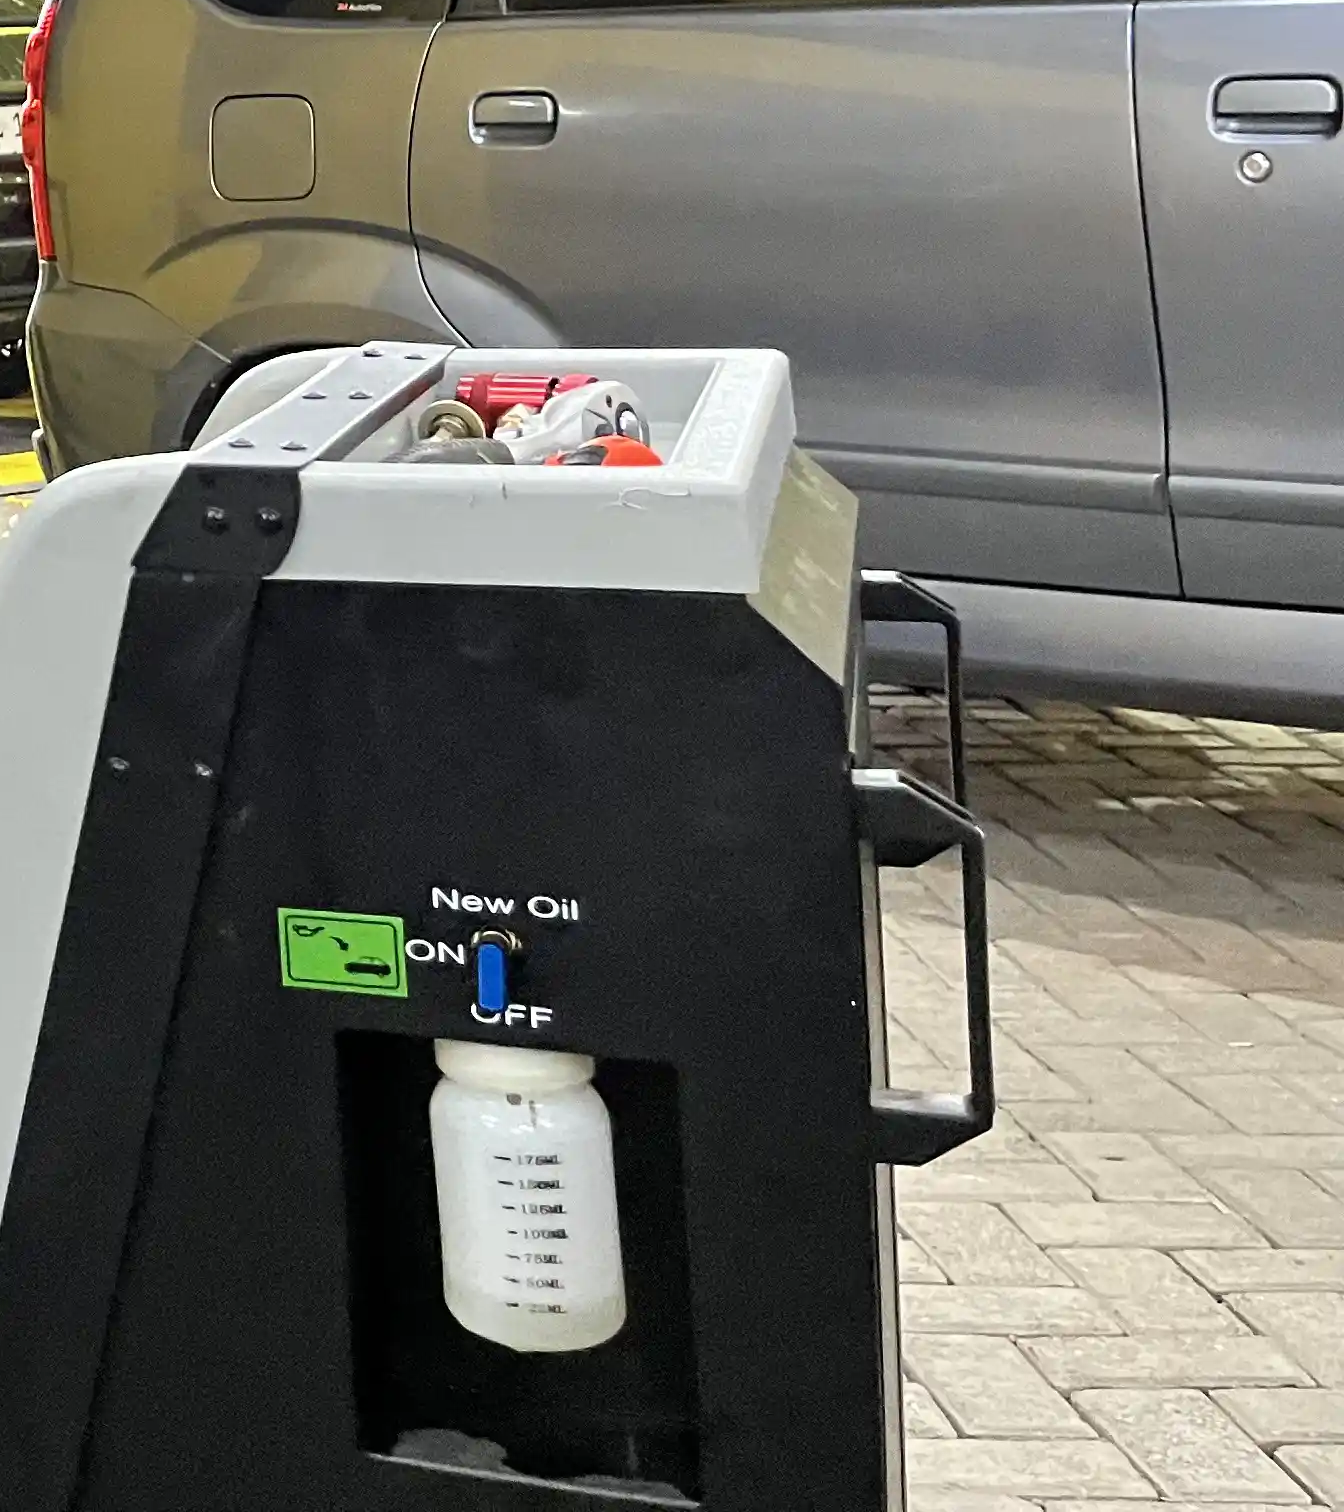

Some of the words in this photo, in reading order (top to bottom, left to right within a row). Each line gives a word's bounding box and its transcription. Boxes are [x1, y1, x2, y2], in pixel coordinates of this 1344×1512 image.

[431, 887, 515, 915] New
[527, 895, 578, 921] Oil
[405, 938, 465, 966] ON
